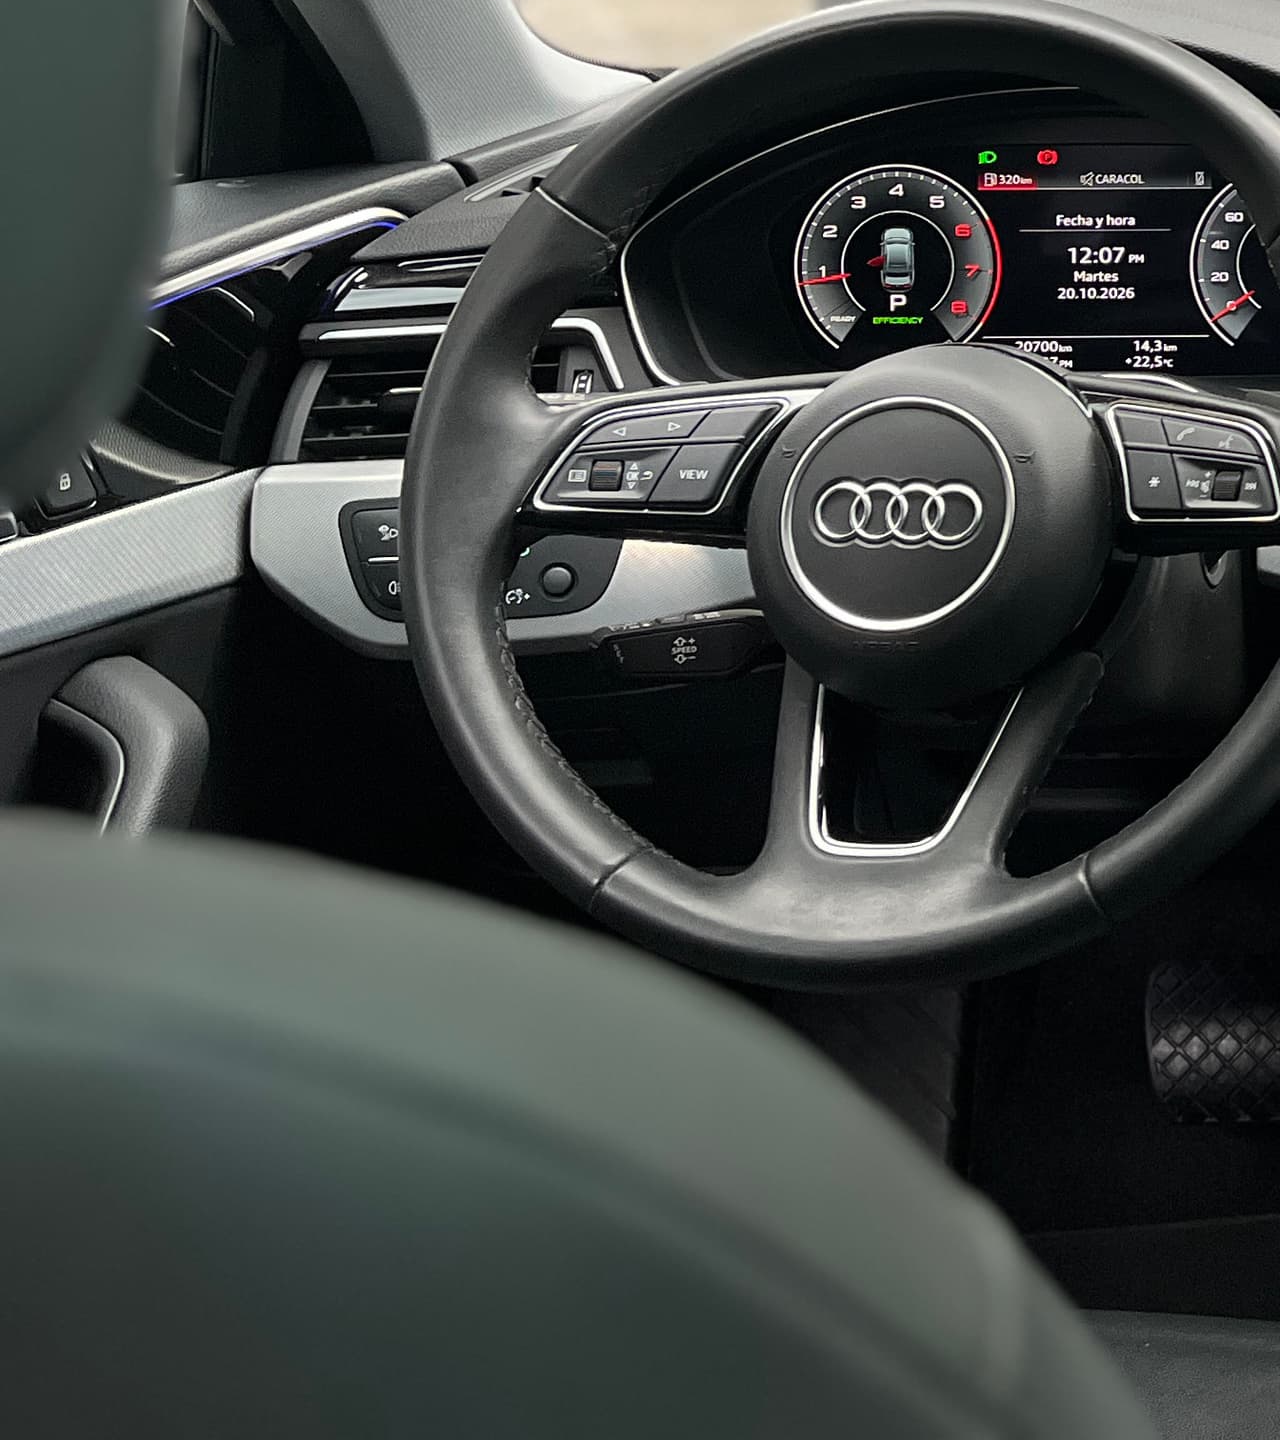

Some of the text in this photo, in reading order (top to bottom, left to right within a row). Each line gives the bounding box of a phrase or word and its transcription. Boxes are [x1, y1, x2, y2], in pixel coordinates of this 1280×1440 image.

[1095, 174, 1144, 184] CARACOL
[889, 184, 904, 196] 4
[851, 196, 866, 208] 3
[929, 196, 945, 208] 5
[1056, 214, 1136, 228] Fecha y hora
[1224, 212, 1244, 222] 60
[822, 225, 838, 237] 2
[954, 224, 971, 236] 6
[1211, 240, 1229, 250] 40
[1067, 247, 1145, 264] 12:07 PM
[818, 265, 827, 278] 1
[965, 265, 980, 277] 7
[1074, 271, 1119, 282] Martes
[1211, 272, 1229, 282] 20
[1057, 287, 1135, 300] 20.10.2026
[890, 294, 907, 311] P
[951, 301, 967, 313] 8
[873, 317, 923, 325] EFFICIENCY
[626, 471, 639, 480] OK
[679, 469, 708, 479] VIEW
[672, 646, 697, 654] SPEED
